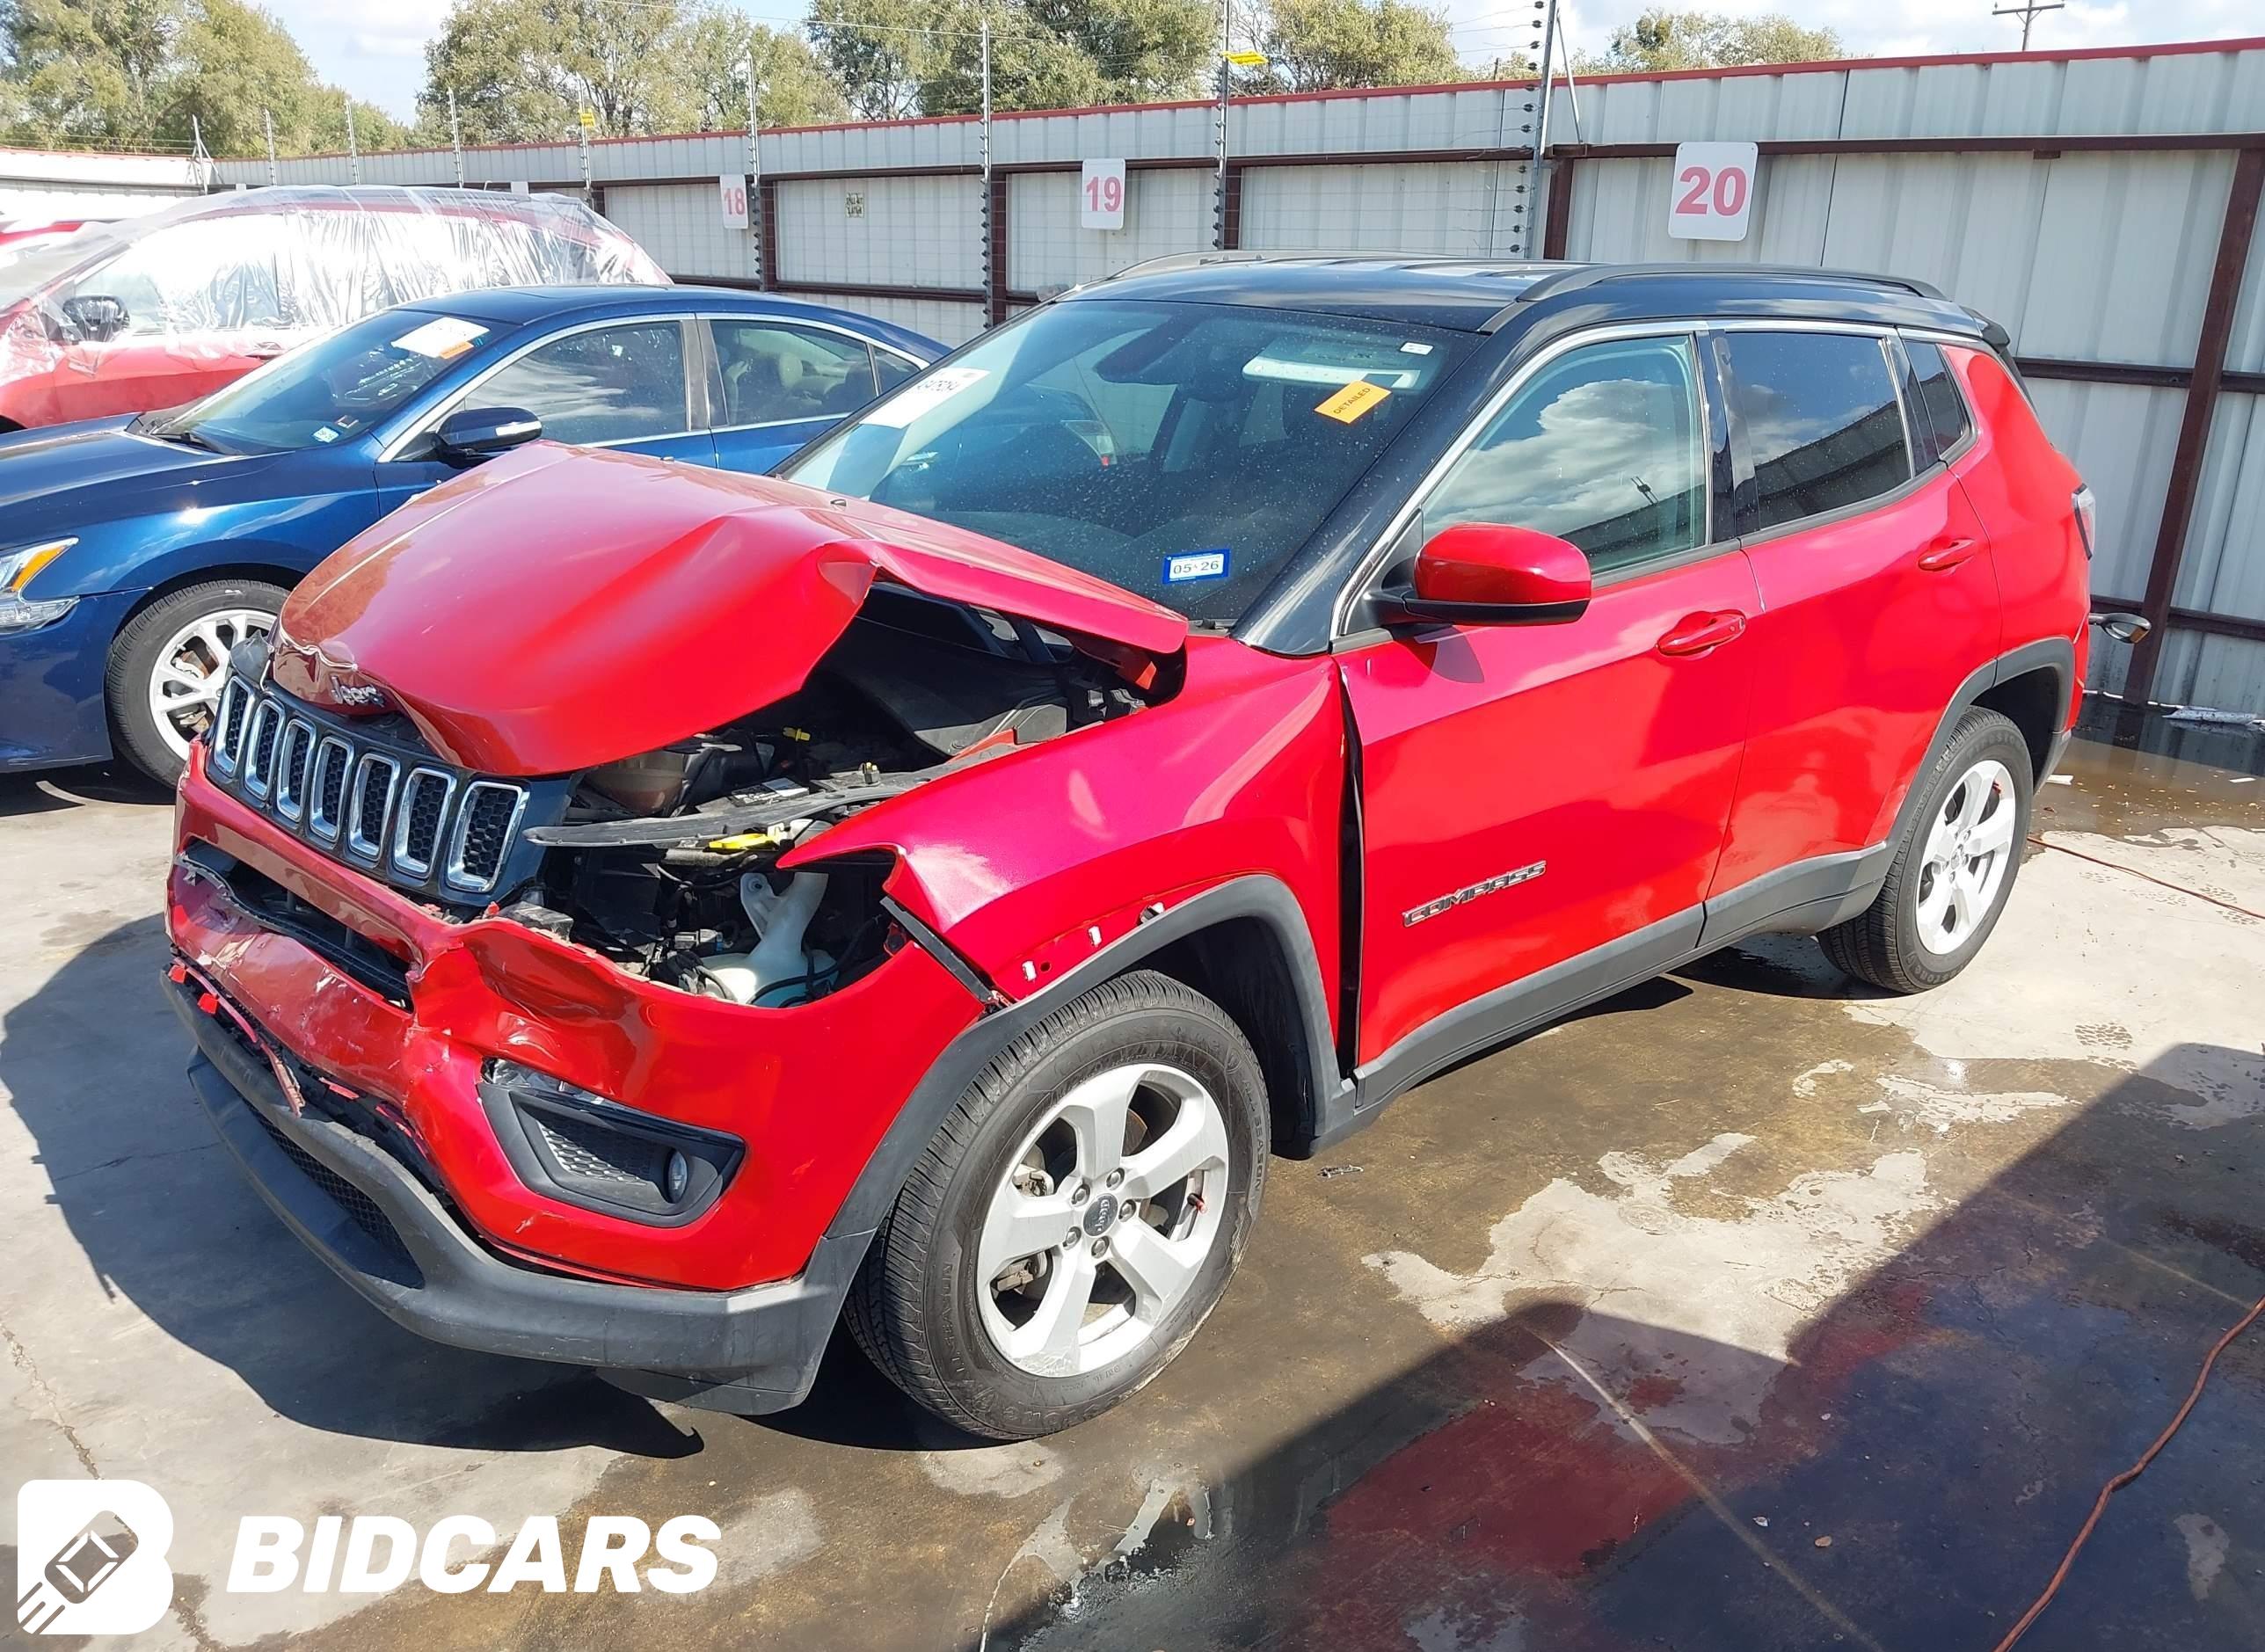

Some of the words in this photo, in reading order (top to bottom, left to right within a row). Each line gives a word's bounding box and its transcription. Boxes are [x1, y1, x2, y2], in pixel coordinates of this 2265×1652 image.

[724, 187, 746, 215] 18
[1086, 176, 1121, 212] 19
[1675, 166, 1747, 216] 20
[1333, 387, 1371, 414] DETAILED
[1402, 859, 1547, 928] COMPASS
